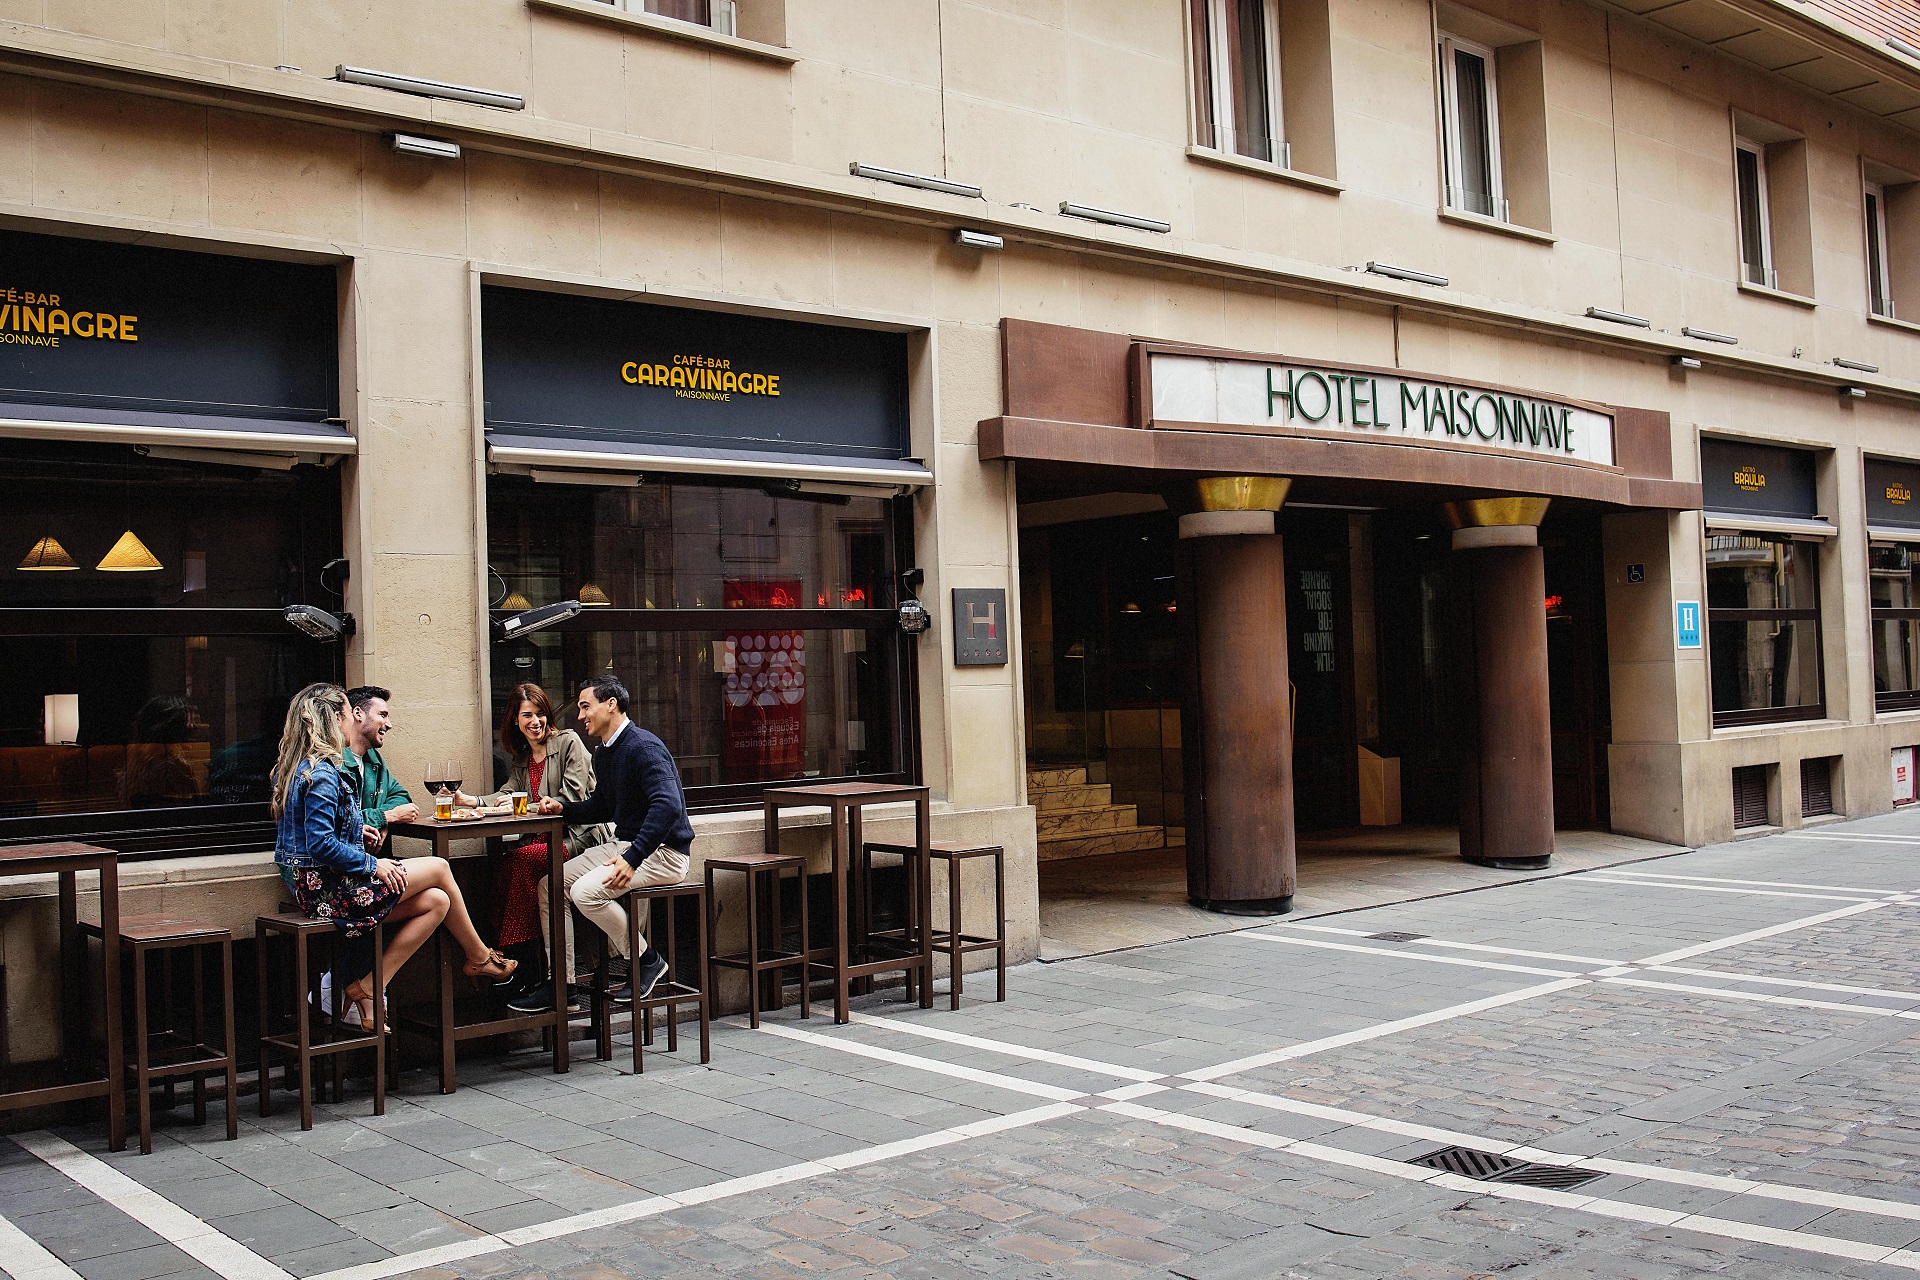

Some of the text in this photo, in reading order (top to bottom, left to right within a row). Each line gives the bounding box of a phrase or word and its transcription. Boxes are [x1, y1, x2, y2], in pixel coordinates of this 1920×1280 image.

[673, 354, 731, 369] CAFÉ-BAR
[621, 361, 781, 396] CARAVINAGRE
[675, 389, 731, 402] MAISONNAVE
[1266, 367, 1576, 452] HOTEL MAISONNAVE
[1734, 471, 1766, 487] BRAULIA
[1300, 570, 1331, 590] CHANGE
[1304, 591, 1332, 610] SOCIAL
[965, 602, 998, 640] H
[1317, 611, 1334, 631] FOR
[1682, 607, 1695, 631] H
[1303, 632, 1334, 651] MAKING
